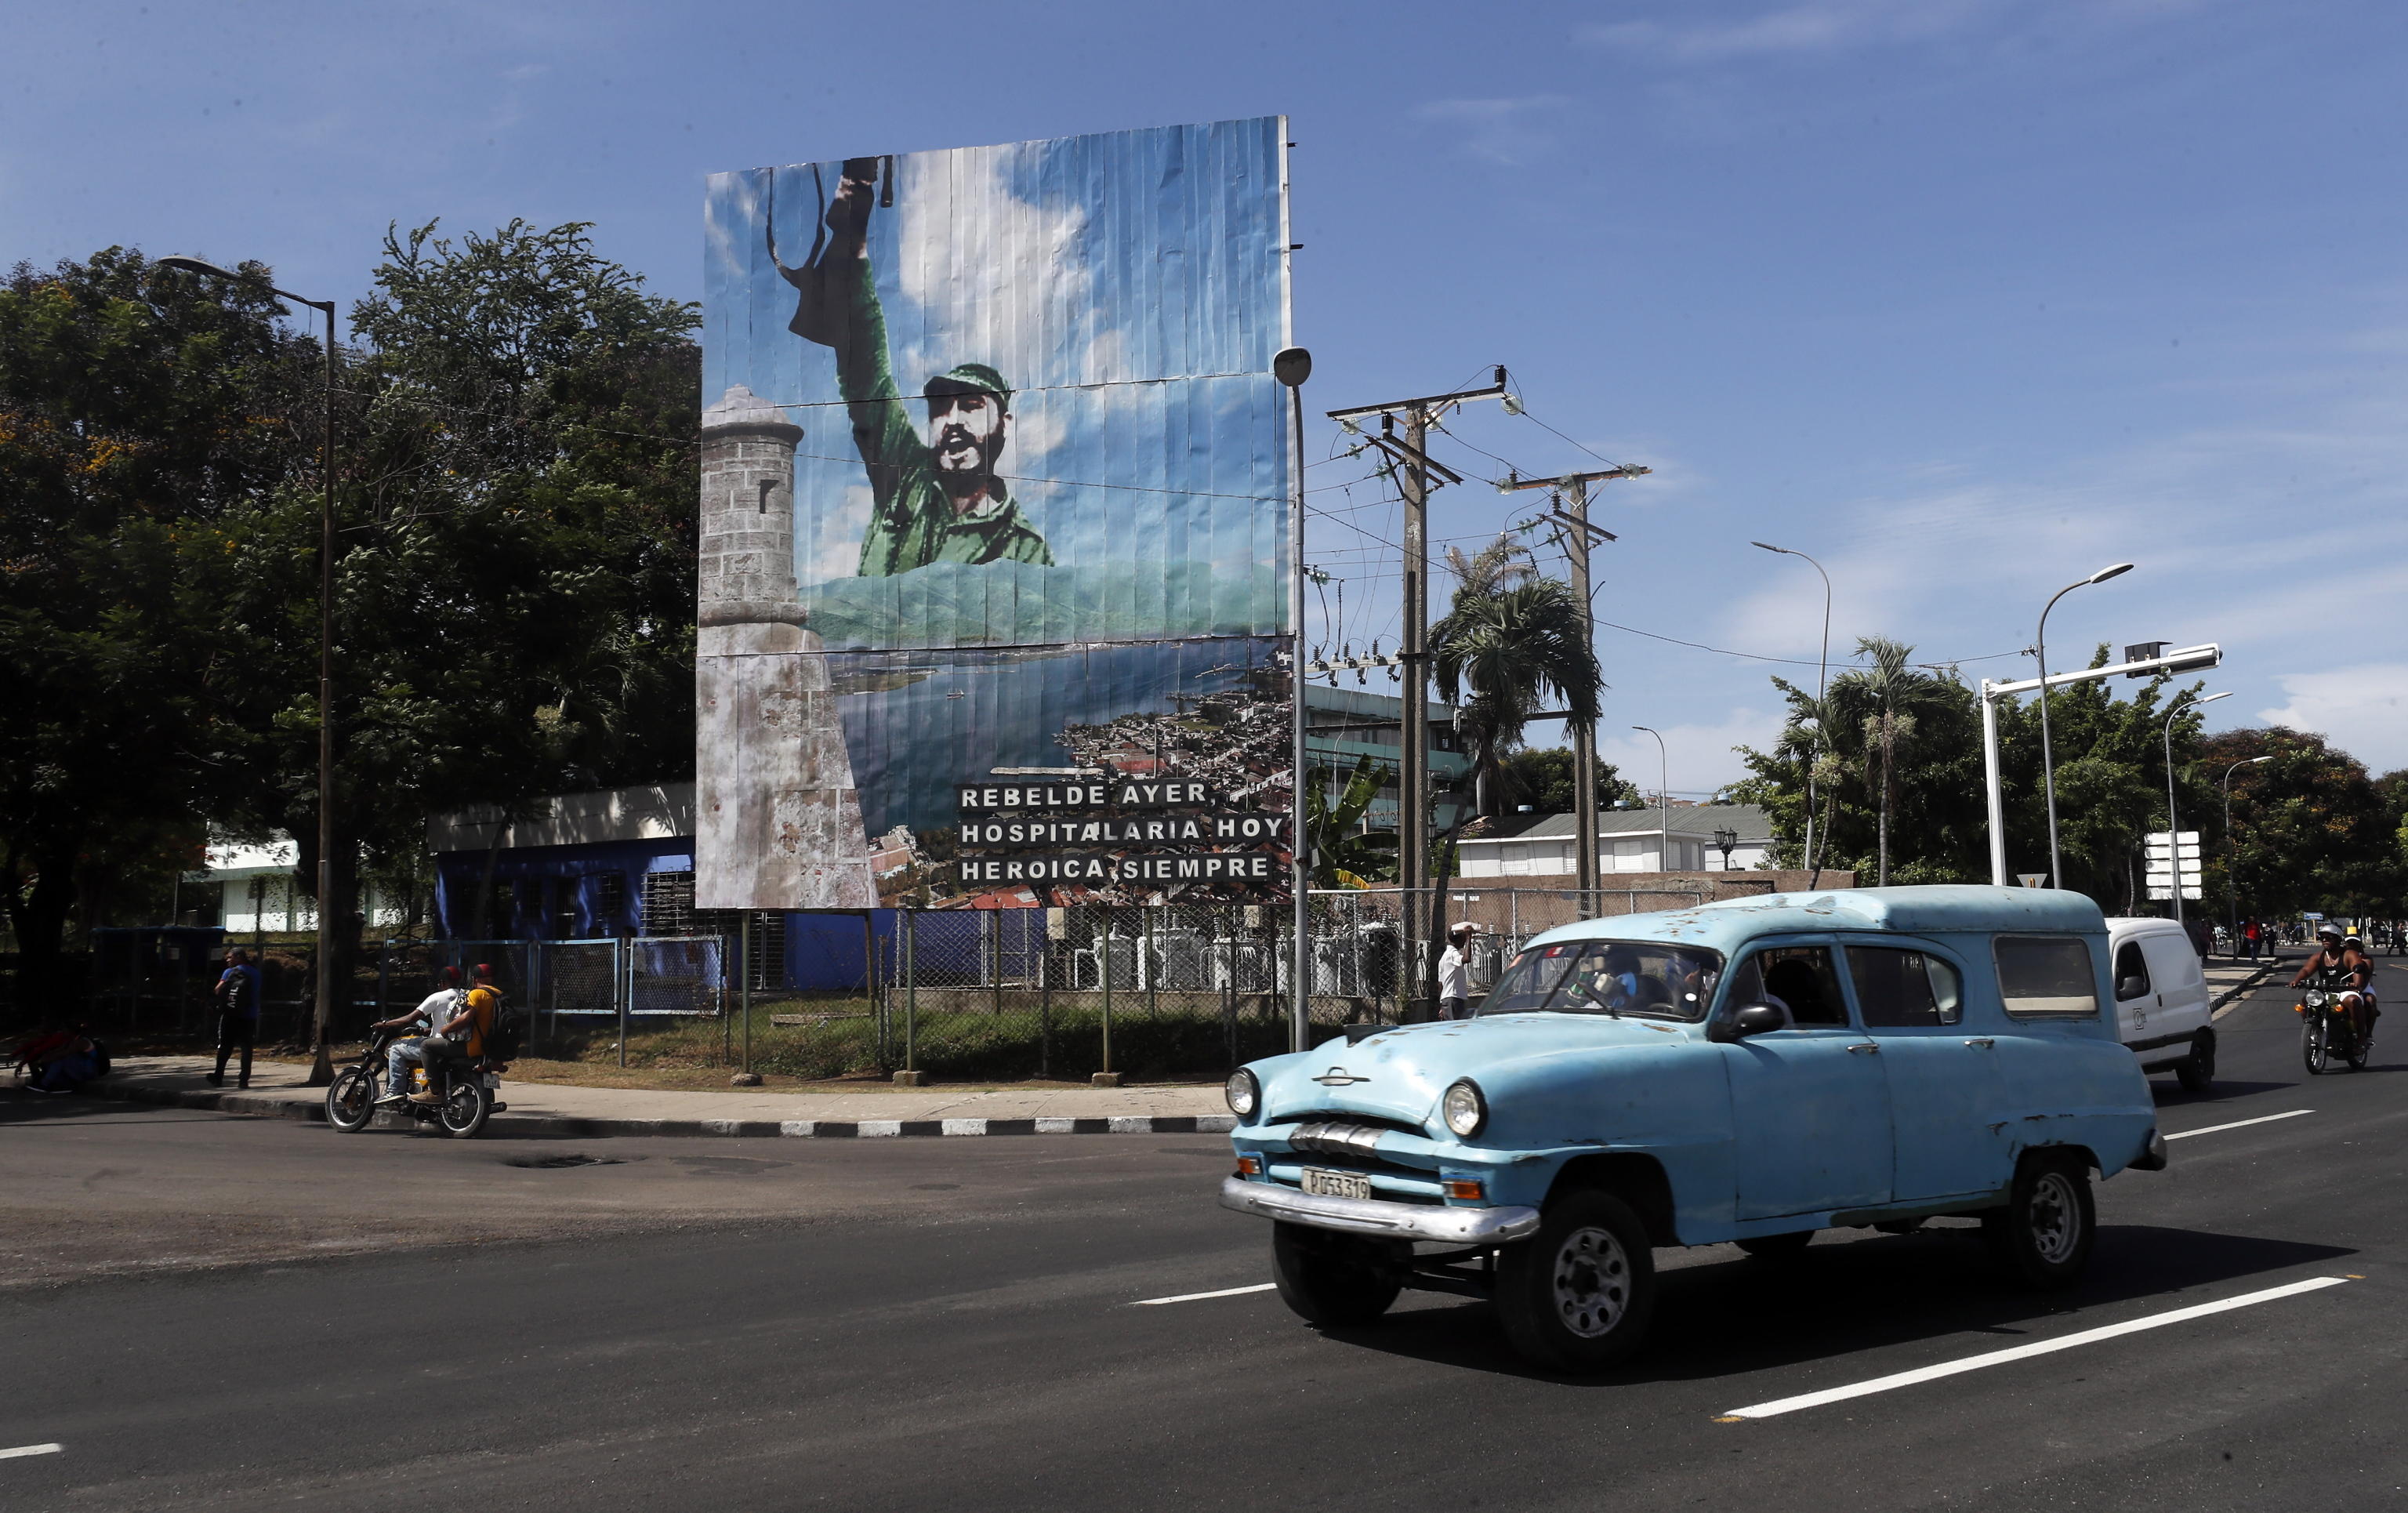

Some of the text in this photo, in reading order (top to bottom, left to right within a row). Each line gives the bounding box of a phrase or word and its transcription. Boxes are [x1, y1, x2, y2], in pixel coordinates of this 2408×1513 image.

[962, 783, 1216, 807] REBELDE AYER,
[962, 818, 1282, 843] HOSPITALARIA HOY
[962, 858, 1267, 880] HEROICA SIEMPRE
